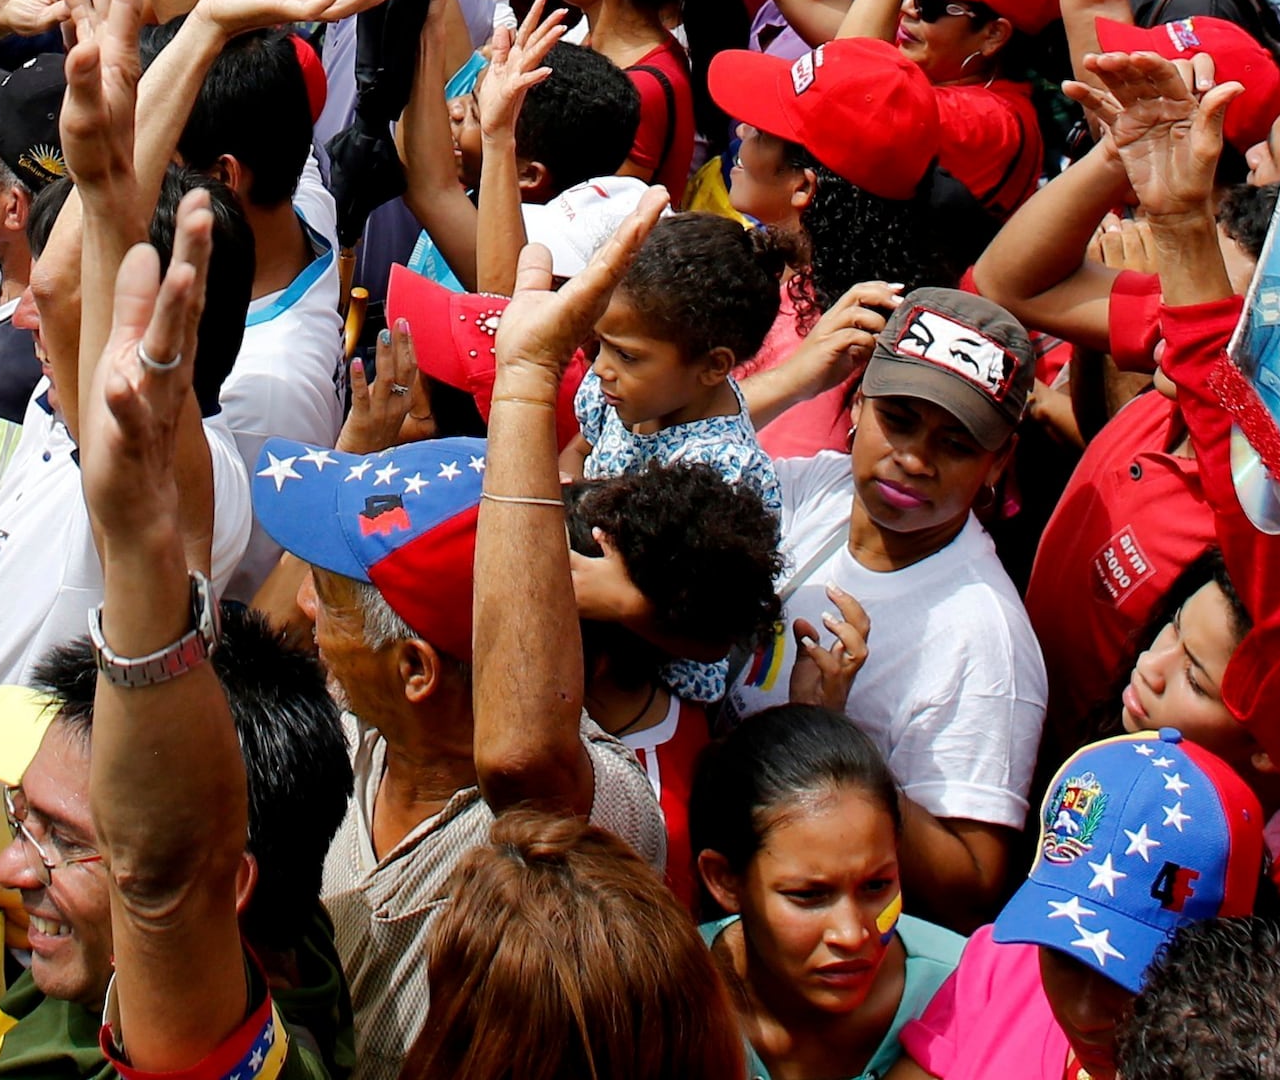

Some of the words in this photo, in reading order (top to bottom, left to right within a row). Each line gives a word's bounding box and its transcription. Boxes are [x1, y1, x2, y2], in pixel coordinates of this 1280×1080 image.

[1103, 547, 1131, 588] 2000
[1120, 534, 1148, 575] arm
[1149, 860, 1201, 913] 4F
